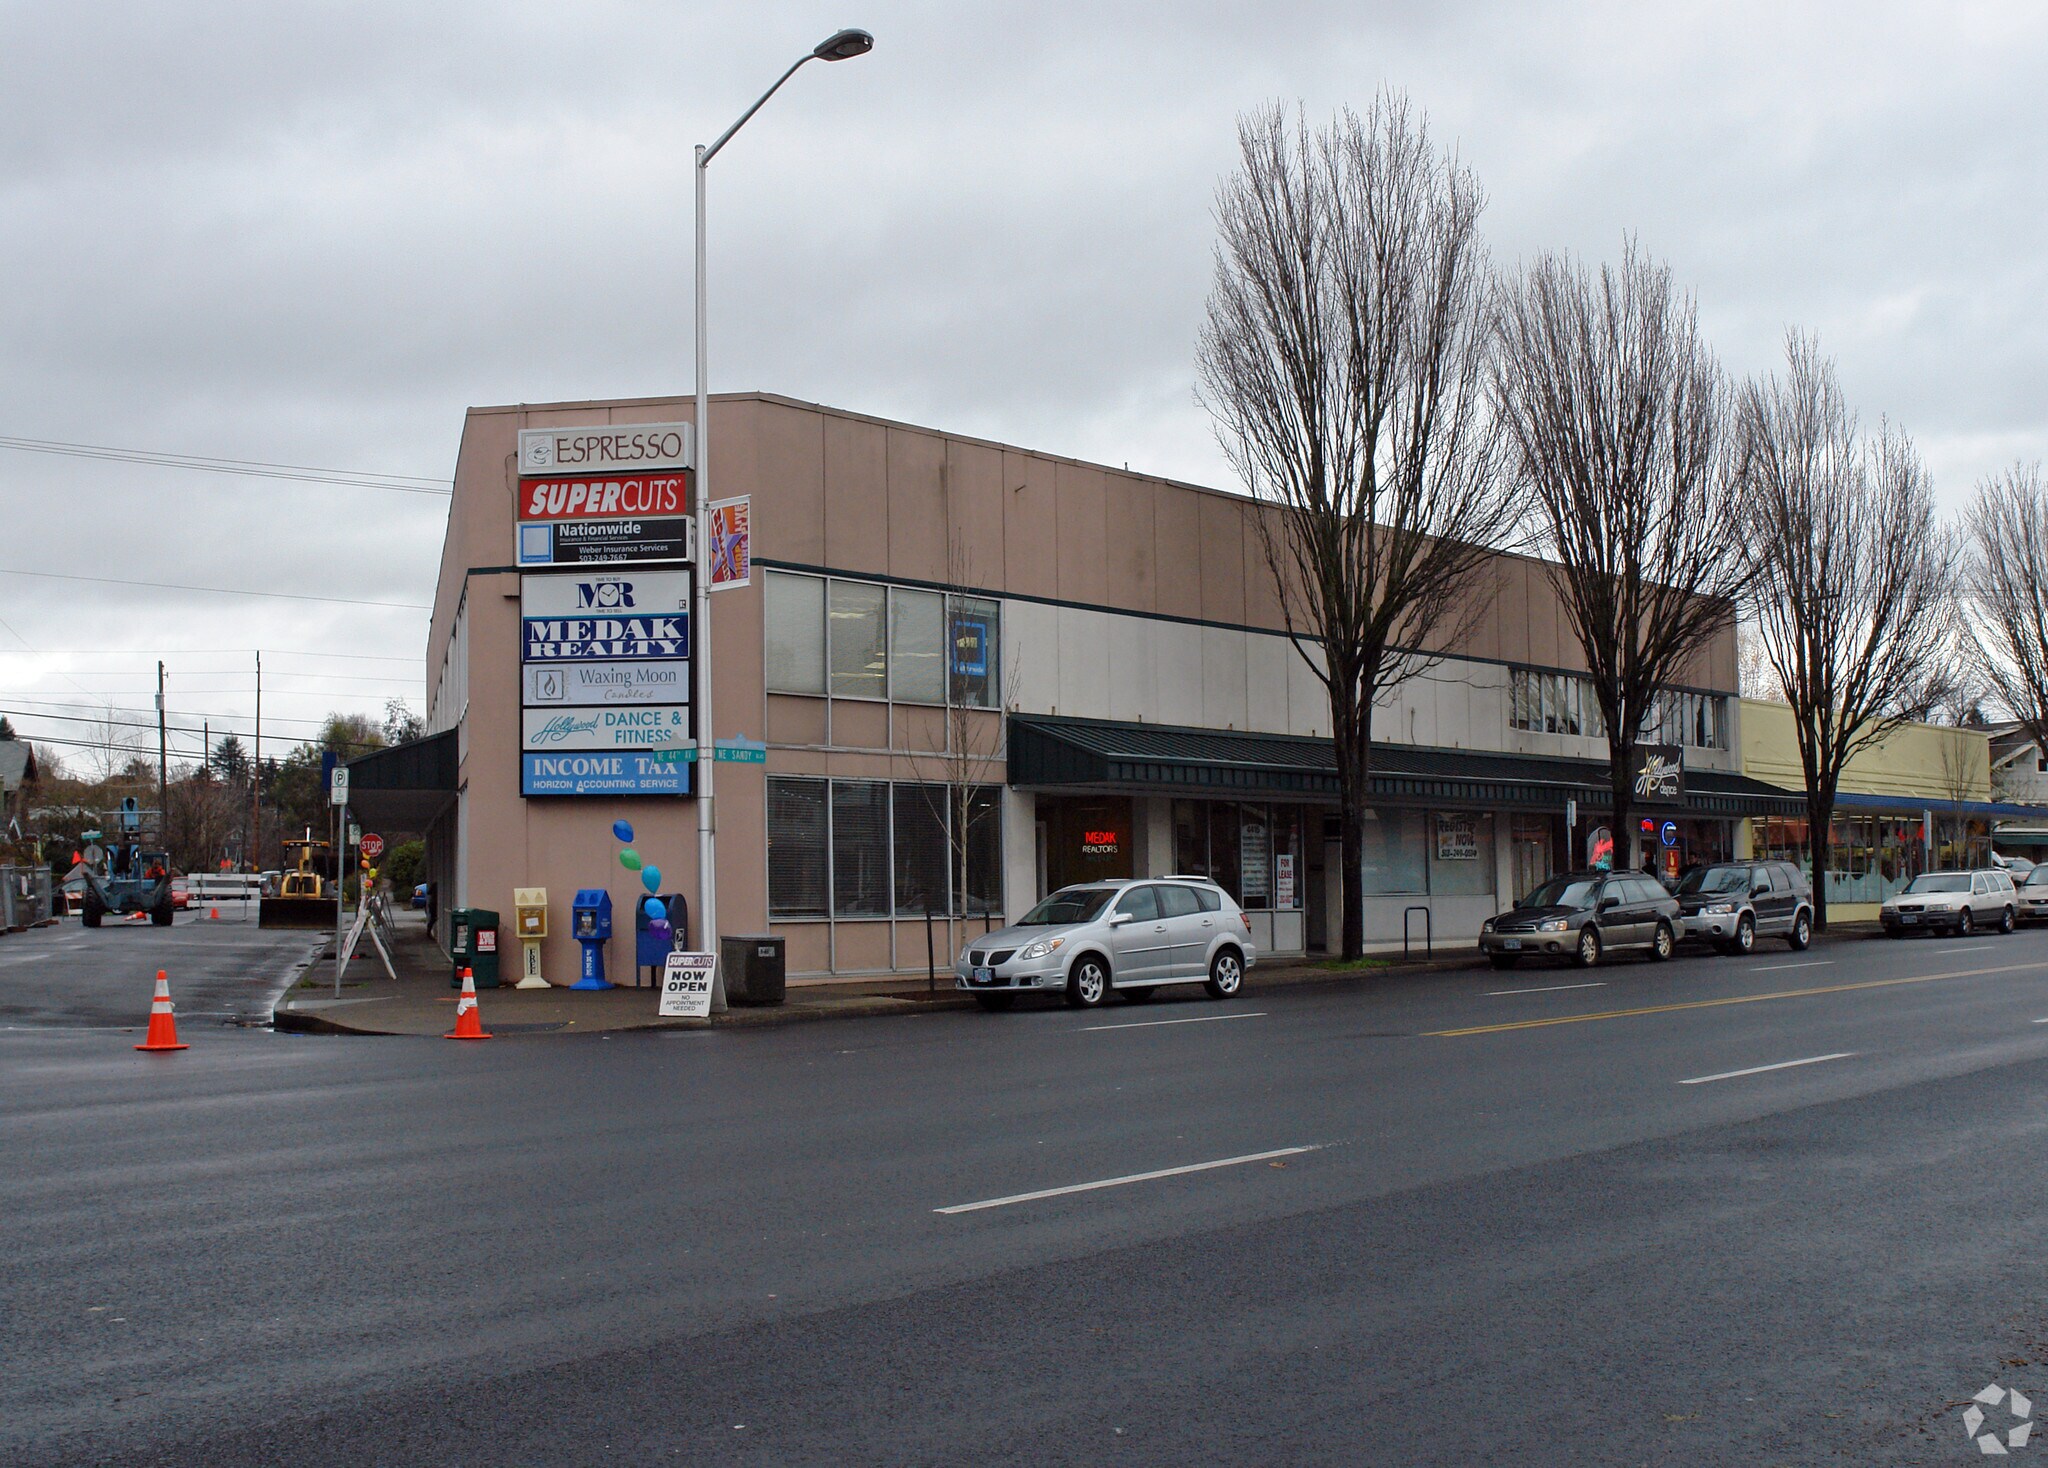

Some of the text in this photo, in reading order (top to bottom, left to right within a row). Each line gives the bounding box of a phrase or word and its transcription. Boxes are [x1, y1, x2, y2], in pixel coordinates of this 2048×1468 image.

[556, 432, 682, 463] ESPRESSO
[528, 479, 681, 515] SUPERCUTS
[559, 522, 642, 537] Nationwide
[578, 543, 668, 554] Weber Insurance Services
[529, 618, 684, 642] MEDAK
[529, 639, 684, 657] REALTY
[579, 667, 677, 688] Waxing Moon
[604, 688, 654, 700] Candles
[605, 710, 682, 726] DANCE &
[530, 713, 600, 745] Hollywood
[615, 729, 672, 744] FITNESS
[718, 750, 726, 759] NE
[732, 750, 752, 760] SANDY
[533, 758, 678, 776] INCOME TAX
[1635, 752, 1682, 796] Hollywood
[533, 779, 678, 789] HORIZON ACCOUNTING SERVICE
[1085, 831, 1117, 844] MEDAK
[361, 840, 382, 850] STOP
[1082, 845, 1118, 854] REALTORS
[1280, 858, 1290, 867] FOR
[1278, 870, 1293, 879] LEASE
[585, 949, 593, 976] FREE
[668, 956, 713, 967] SUPERCUTS
[671, 971, 706, 981] NOW
[668, 982, 707, 992] OPEN
